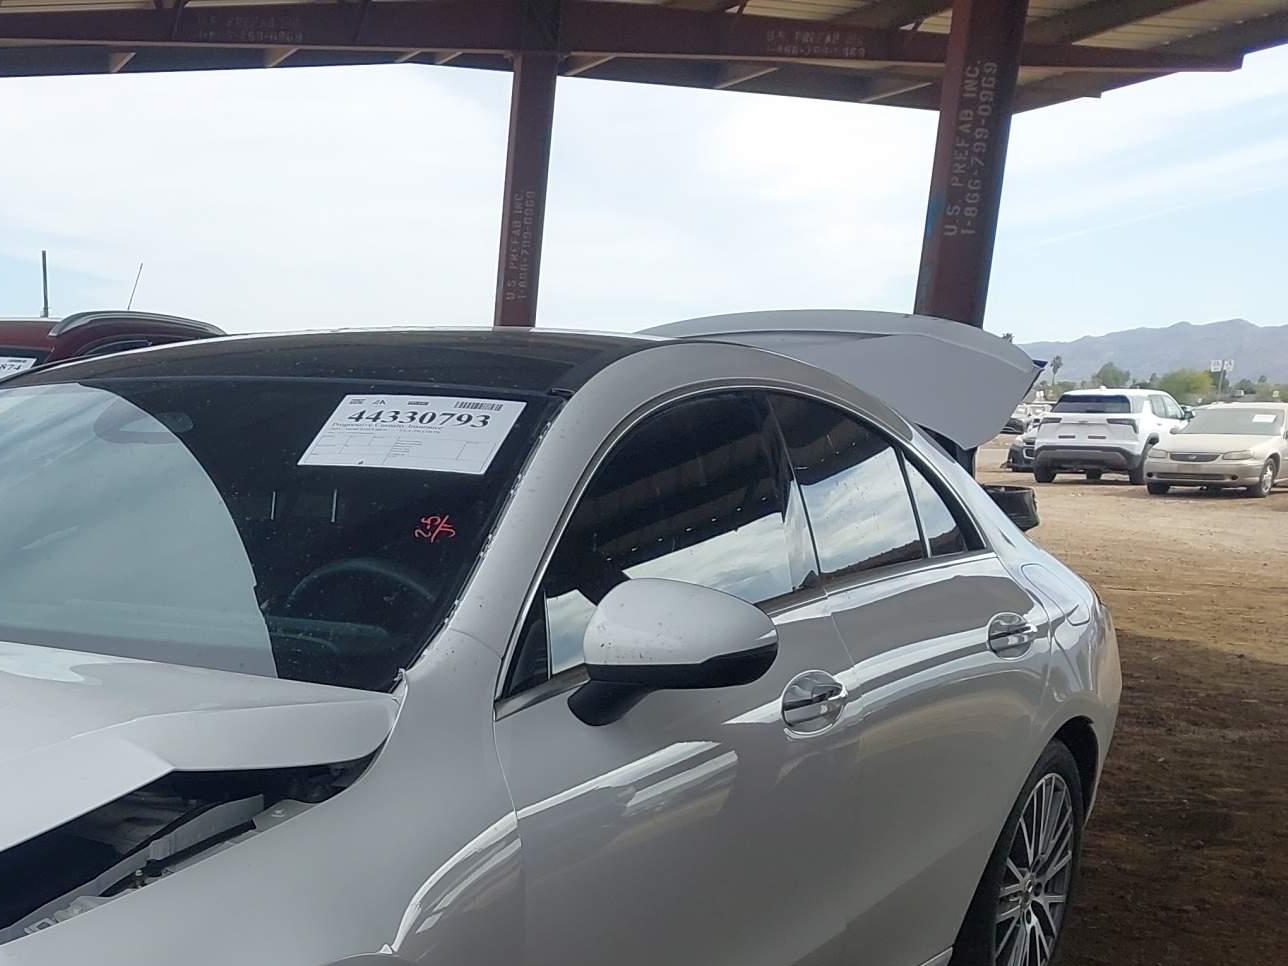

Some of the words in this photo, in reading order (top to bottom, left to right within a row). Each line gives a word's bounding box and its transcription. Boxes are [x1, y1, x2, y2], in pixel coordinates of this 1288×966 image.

[962, 59, 982, 98] INC.
[951, 108, 974, 187] PREFAB
[347, 410, 491, 428] 44330793
